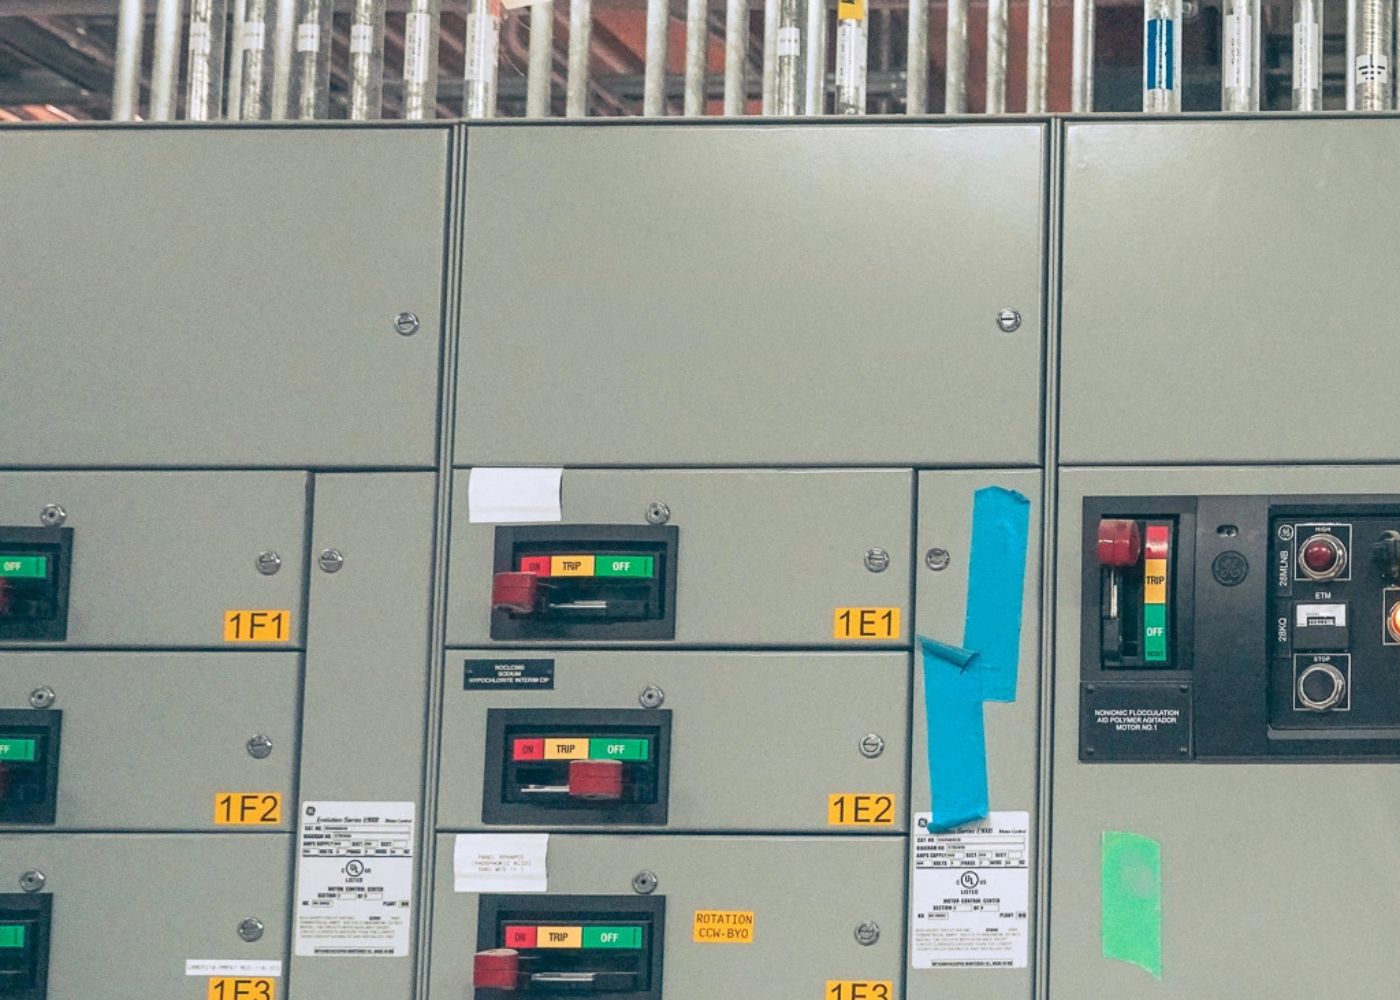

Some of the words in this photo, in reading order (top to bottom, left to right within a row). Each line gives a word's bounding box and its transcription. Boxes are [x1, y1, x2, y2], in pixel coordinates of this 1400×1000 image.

[562, 561, 582, 571] TRIP
[611, 561, 631, 571] OFF
[1146, 575, 1165, 585] TRIP
[1314, 592, 1332, 600] ETM
[230, 612, 282, 639] 1F1
[839, 610, 892, 636] 1E1
[1146, 626, 1164, 637] OFF
[556, 744, 576, 754] TRIP
[607, 744, 626, 754] OFF
[220, 795, 278, 822] 1F2
[834, 796, 892, 822] 1E2
[697, 914, 752, 924] ROTATION
[549, 932, 568, 942] TRIP
[600, 933, 619, 943] OFF
[214, 980, 270, 1000] 1F3
